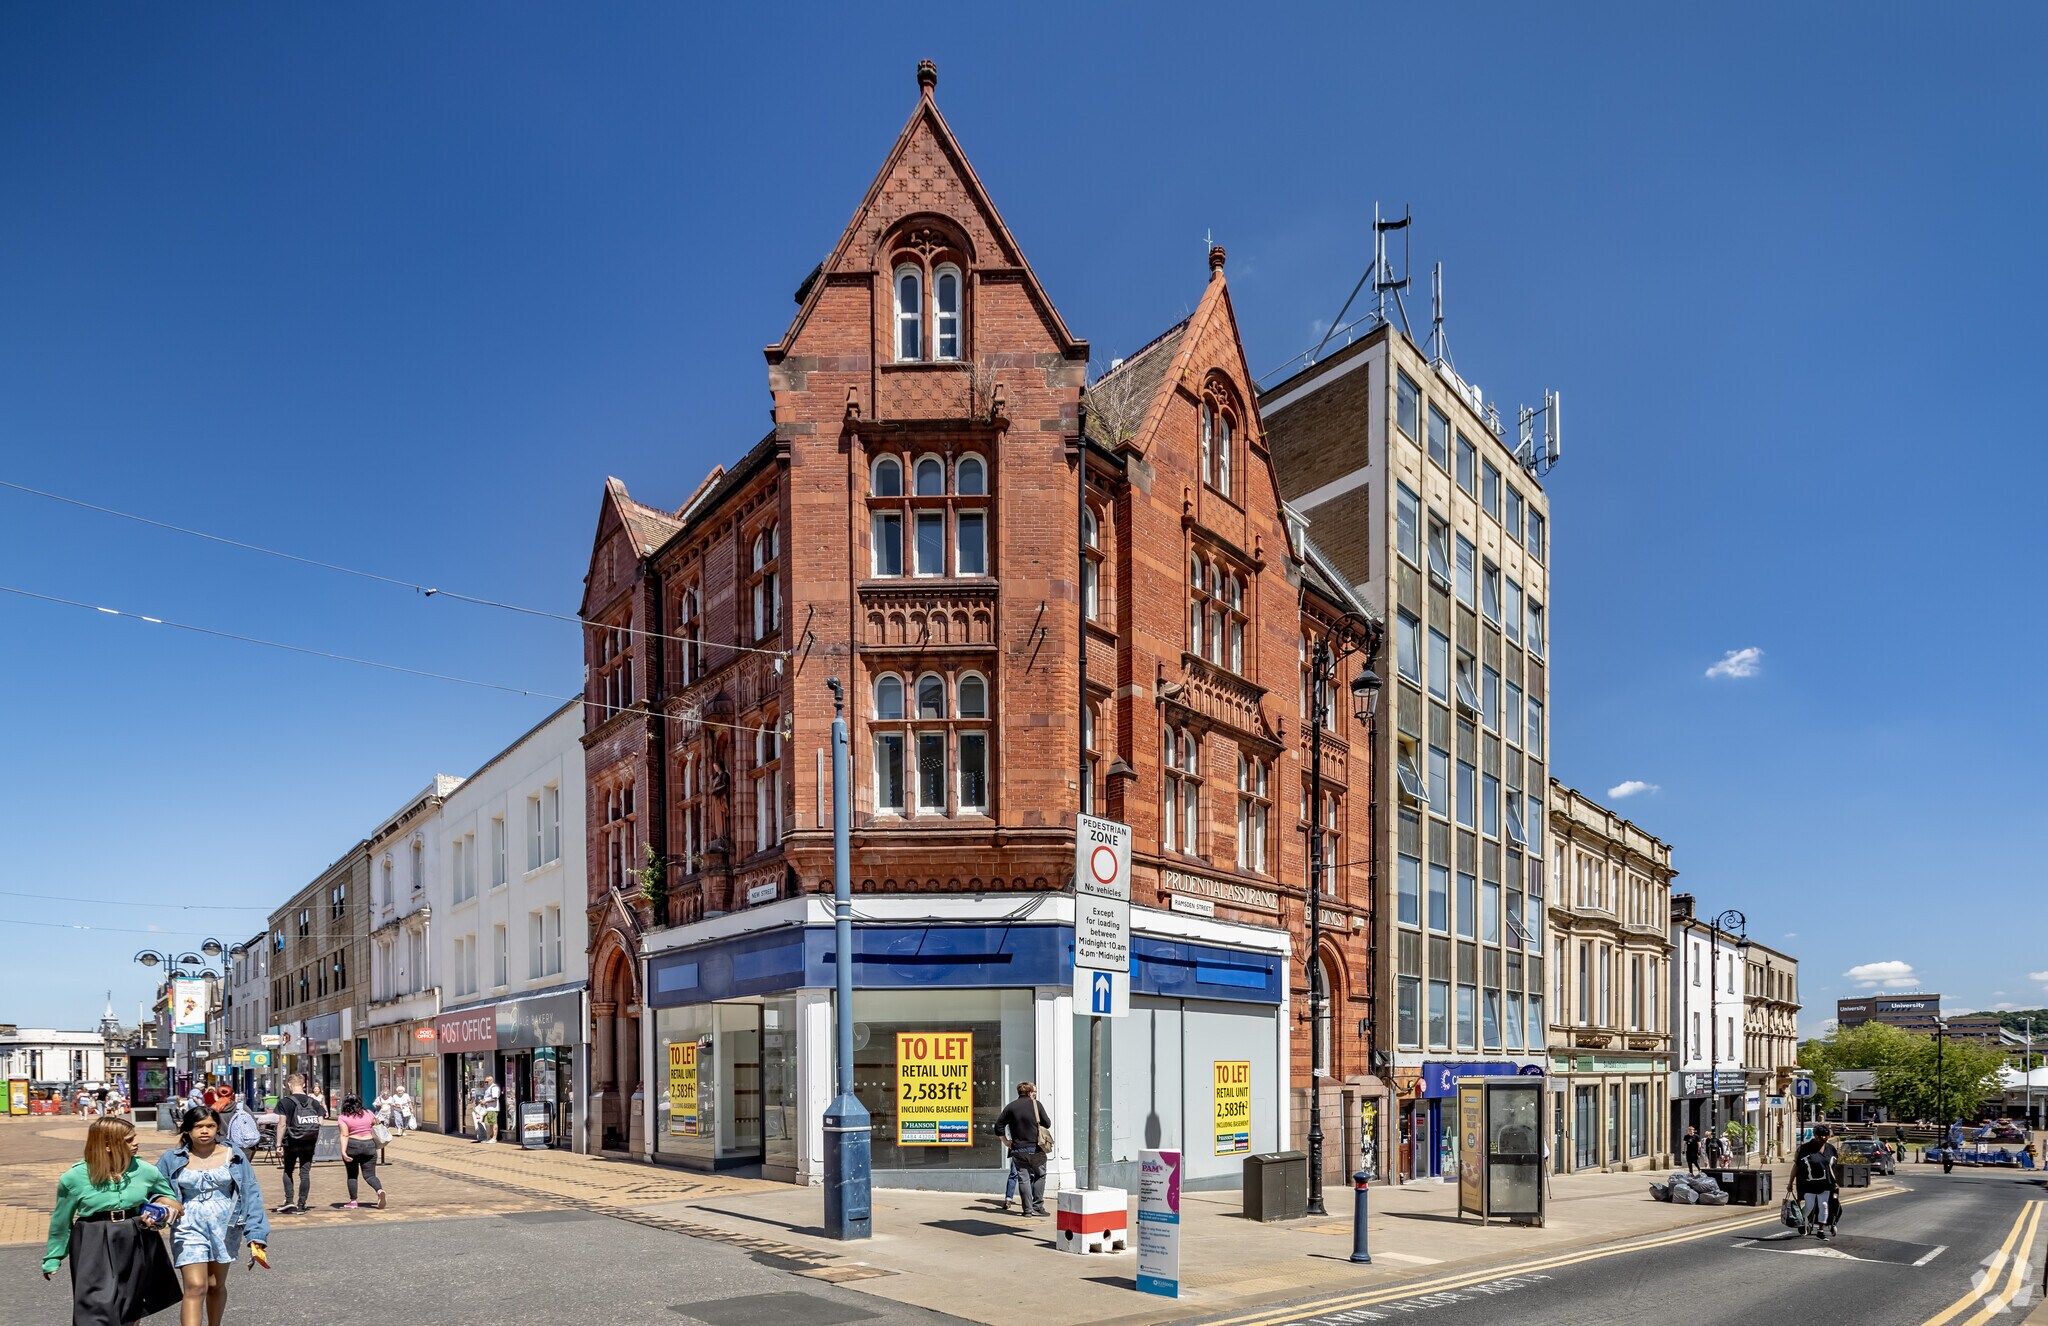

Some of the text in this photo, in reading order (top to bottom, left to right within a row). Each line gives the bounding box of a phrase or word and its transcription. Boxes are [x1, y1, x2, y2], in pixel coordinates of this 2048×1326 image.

[1083, 818, 1127, 836] PEDESTRIAN
[1090, 829, 1119, 846] ZONE
[751, 887, 774, 899] NEW STREET
[1084, 883, 1122, 897] No vehicles
[1174, 899, 1212, 912] RAMSDEN STREET
[1092, 907, 1114, 918] Except
[1086, 916, 1120, 931] for loading
[1090, 927, 1117, 939] between
[531, 1012, 554, 1026] BAKERY
[441, 1016, 492, 1044] POST OFFICE
[670, 1045, 696, 1065] TO LET
[901, 1037, 968, 1060] TO LET
[670, 1068, 696, 1079] RETAIL UNIT
[902, 1064, 968, 1077] RETAIL UNIT
[1216, 1064, 1248, 1084] TO LET
[1216, 1087, 1248, 1098] RETAIL UNIT
[901, 1105, 969, 1113] INCLUDING BASEMENT
[297, 1115, 318, 1124] VANS
